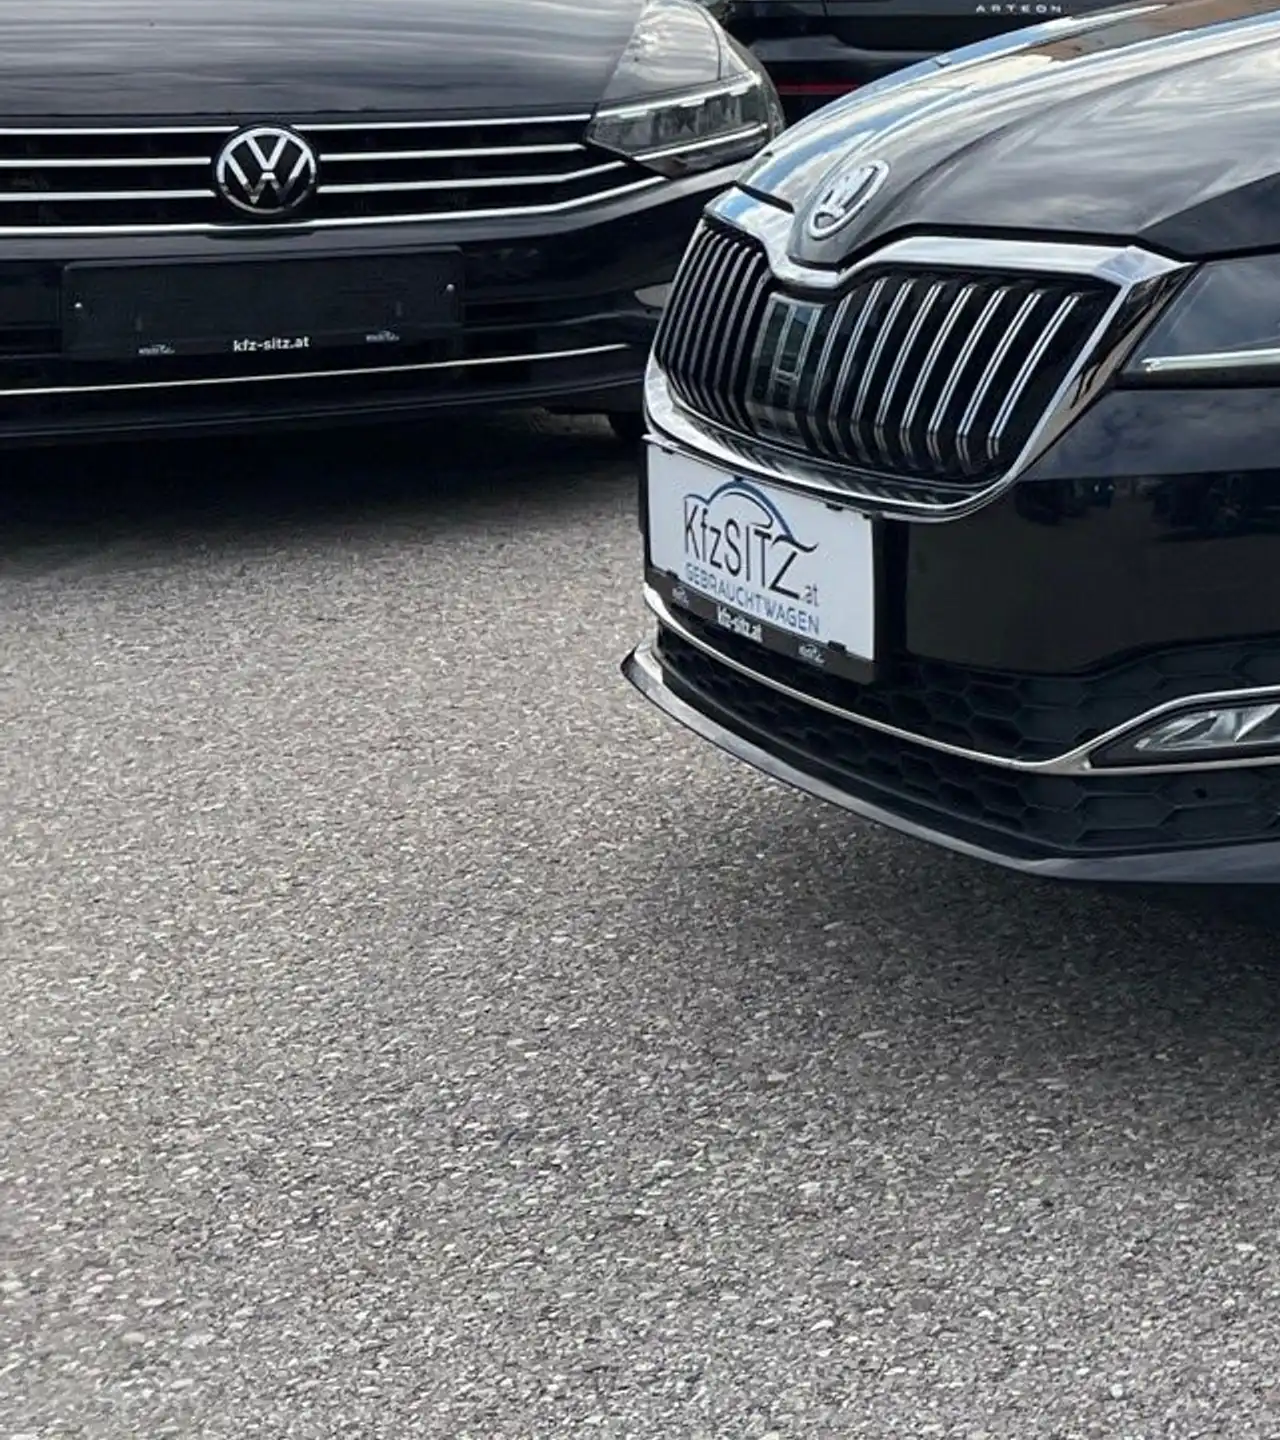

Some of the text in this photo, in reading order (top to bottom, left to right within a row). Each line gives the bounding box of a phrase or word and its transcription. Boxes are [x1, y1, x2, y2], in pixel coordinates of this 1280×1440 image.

[975, 3, 1062, 13] ARTEON
[232, 336, 310, 353] kfz-sitz.at
[685, 561, 820, 635] GEBRAUCHTWAGEN
